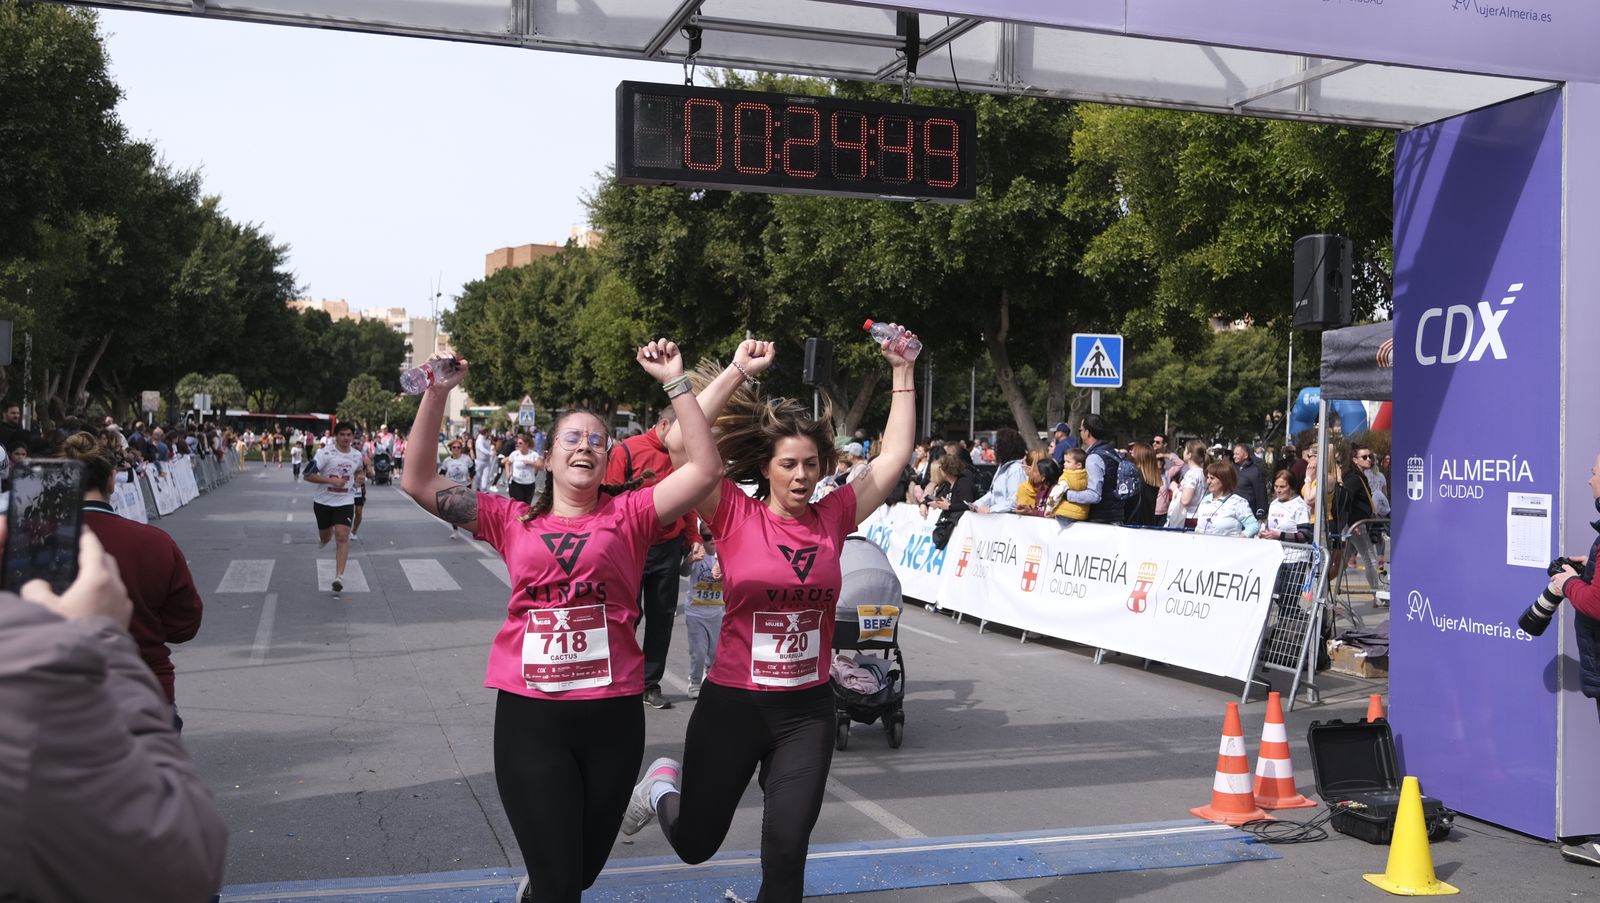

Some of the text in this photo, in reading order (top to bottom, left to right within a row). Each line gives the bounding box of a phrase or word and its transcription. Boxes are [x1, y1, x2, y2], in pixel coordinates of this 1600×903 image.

[1415, 292, 1516, 366] CDX
[1439, 454, 1534, 483] ALMERÍA
[1439, 484, 1484, 499] CIUDAD
[1053, 551, 1128, 586] ALMERÍA
[696, 590, 721, 600] 1519
[1049, 578, 1087, 599] CIUDAD
[1167, 567, 1261, 603] ALMERÍA
[1165, 597, 1211, 620] CIUDAD
[540, 631, 588, 655] 718
[771, 632, 809, 654] 720
[550, 653, 578, 661] CACTUS
